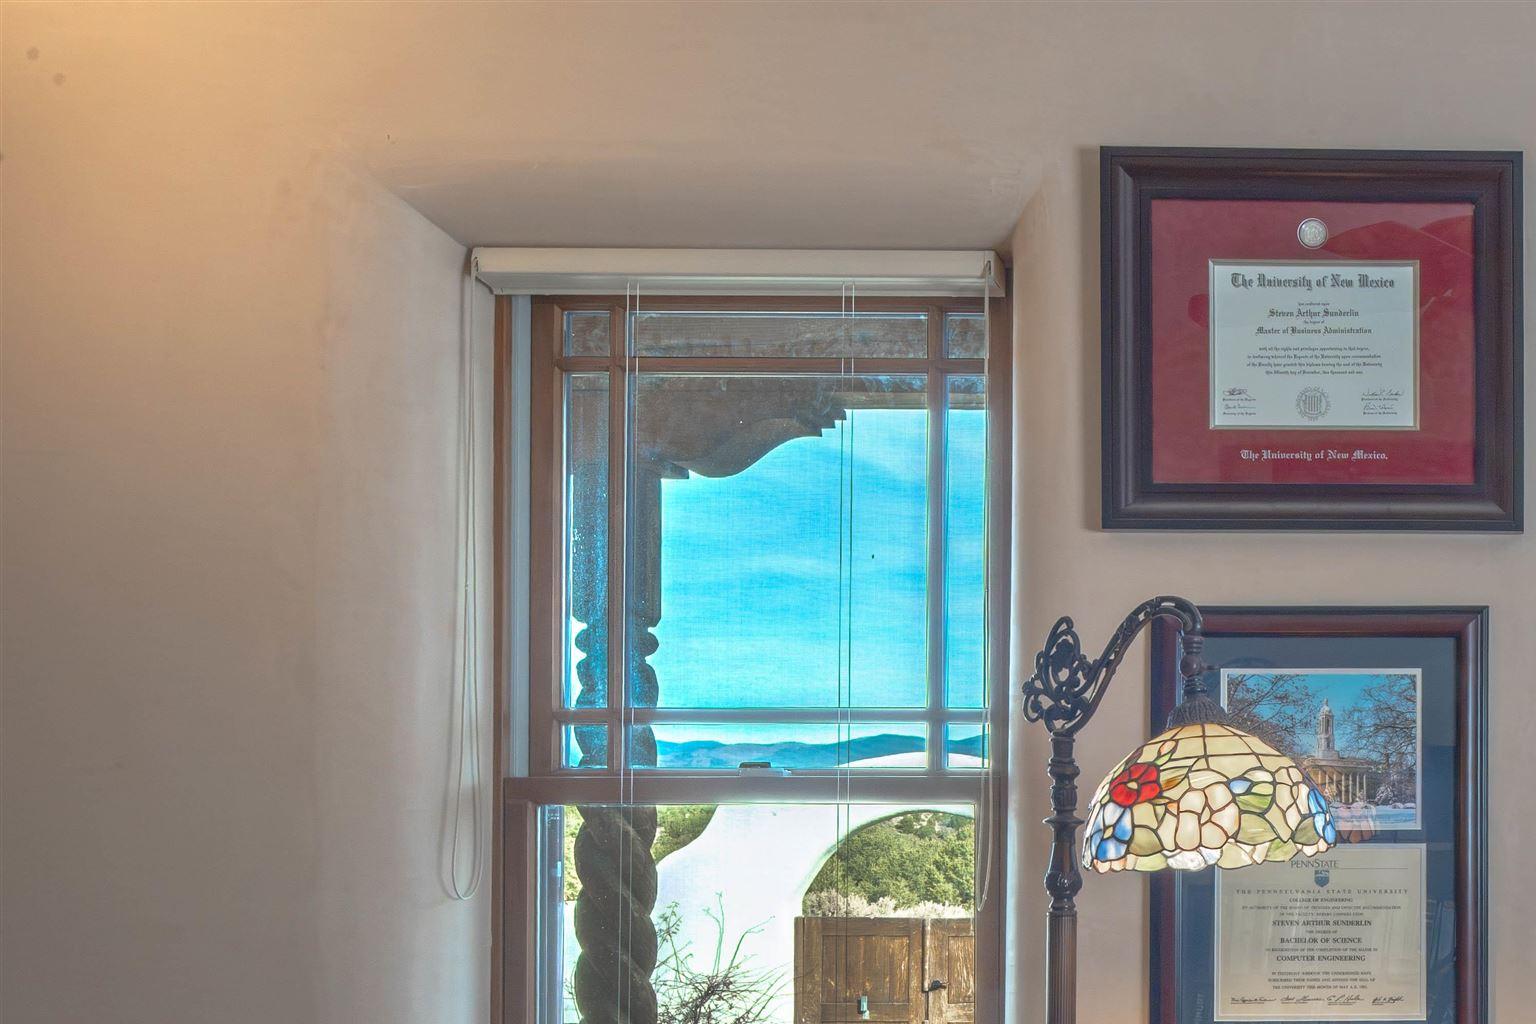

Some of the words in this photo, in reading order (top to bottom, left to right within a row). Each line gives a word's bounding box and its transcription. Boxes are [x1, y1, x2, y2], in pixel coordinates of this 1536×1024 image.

[1231, 272, 1253, 290] The
[1257, 273, 1312, 290] University
[1316, 274, 1327, 288] of
[1330, 273, 1353, 288] New
[1358, 273, 1395, 288] Mexico
[1267, 308, 1294, 319] Steven
[1296, 308, 1322, 319] Arthur
[1323, 308, 1360, 318] Sunderlin
[1256, 326, 1280, 336] Master
[1290, 326, 1322, 336] Business
[1322, 326, 1372, 336] Administration
[1240, 449, 1259, 462] The
[1261, 449, 1313, 462] University
[1314, 449, 1325, 460] of
[1327, 449, 1350, 461] New
[1271, 919, 1300, 927] STEVEN
[1302, 919, 1331, 927] ARTHUR
[1332, 919, 1372, 927] SUNDERLIN
